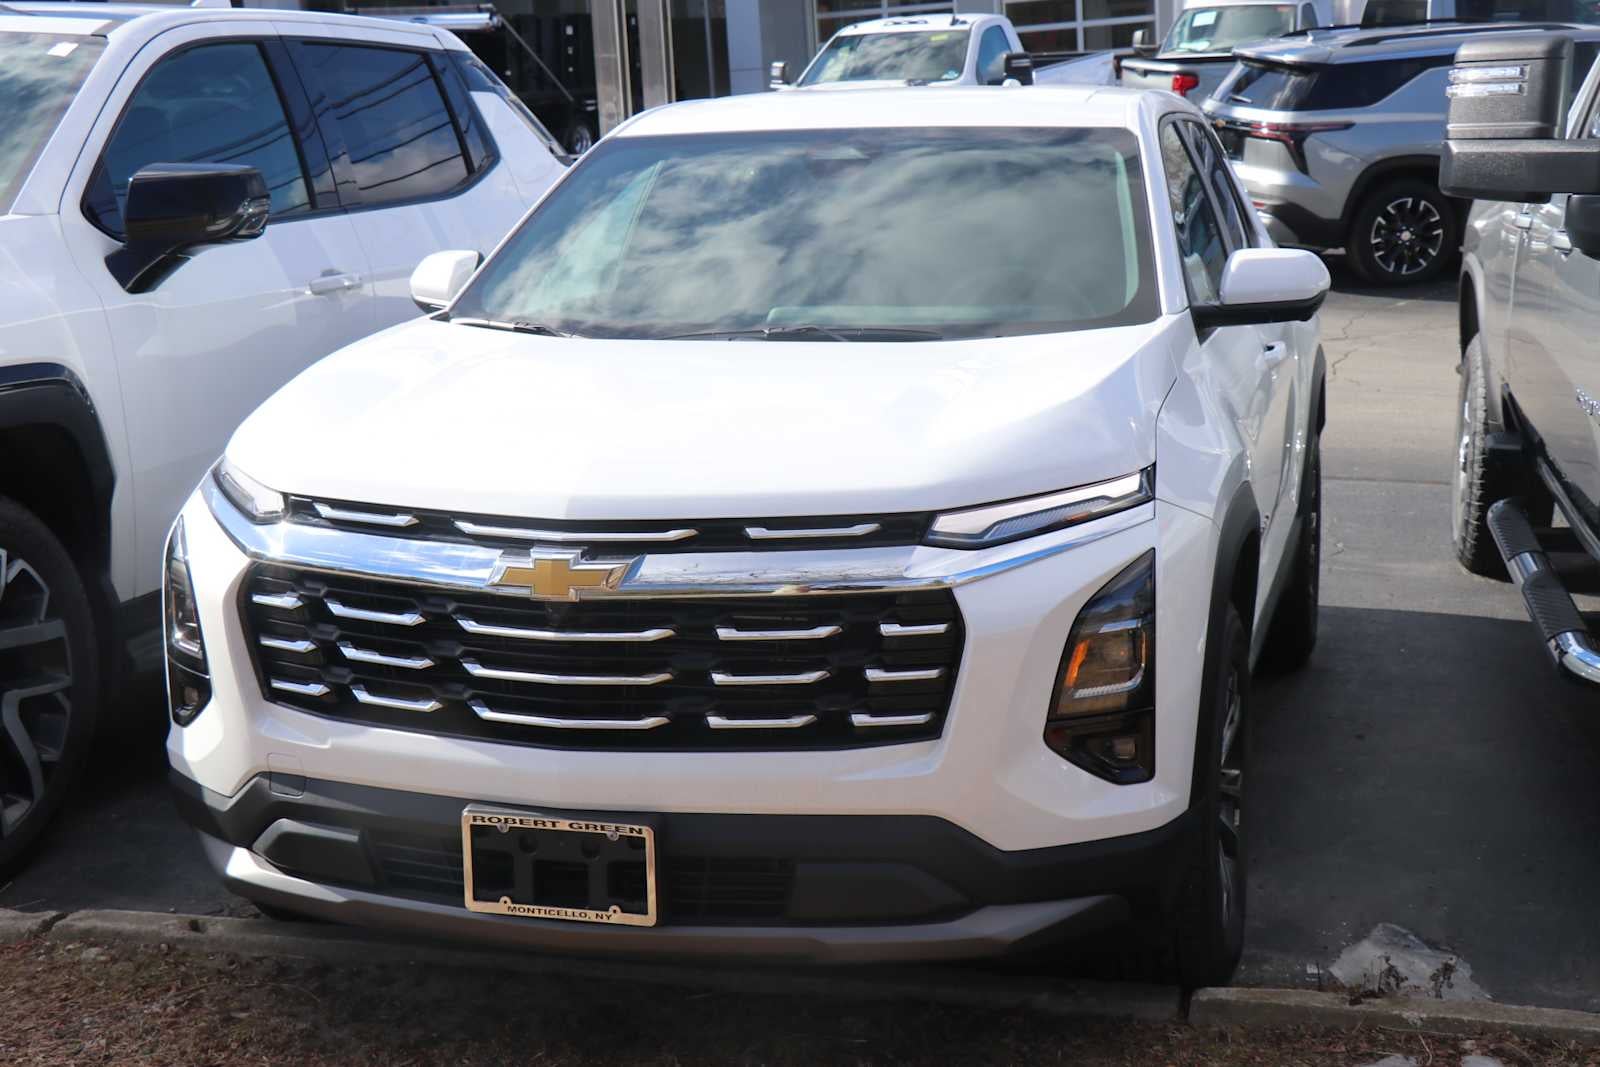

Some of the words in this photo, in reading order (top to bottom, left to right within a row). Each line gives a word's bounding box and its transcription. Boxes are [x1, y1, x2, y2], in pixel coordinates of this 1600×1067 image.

[472, 815, 560, 828] ROBERT
[568, 822, 643, 834] GREEN
[507, 905, 591, 919] MONTICELLO,
[595, 913, 613, 921] NY
